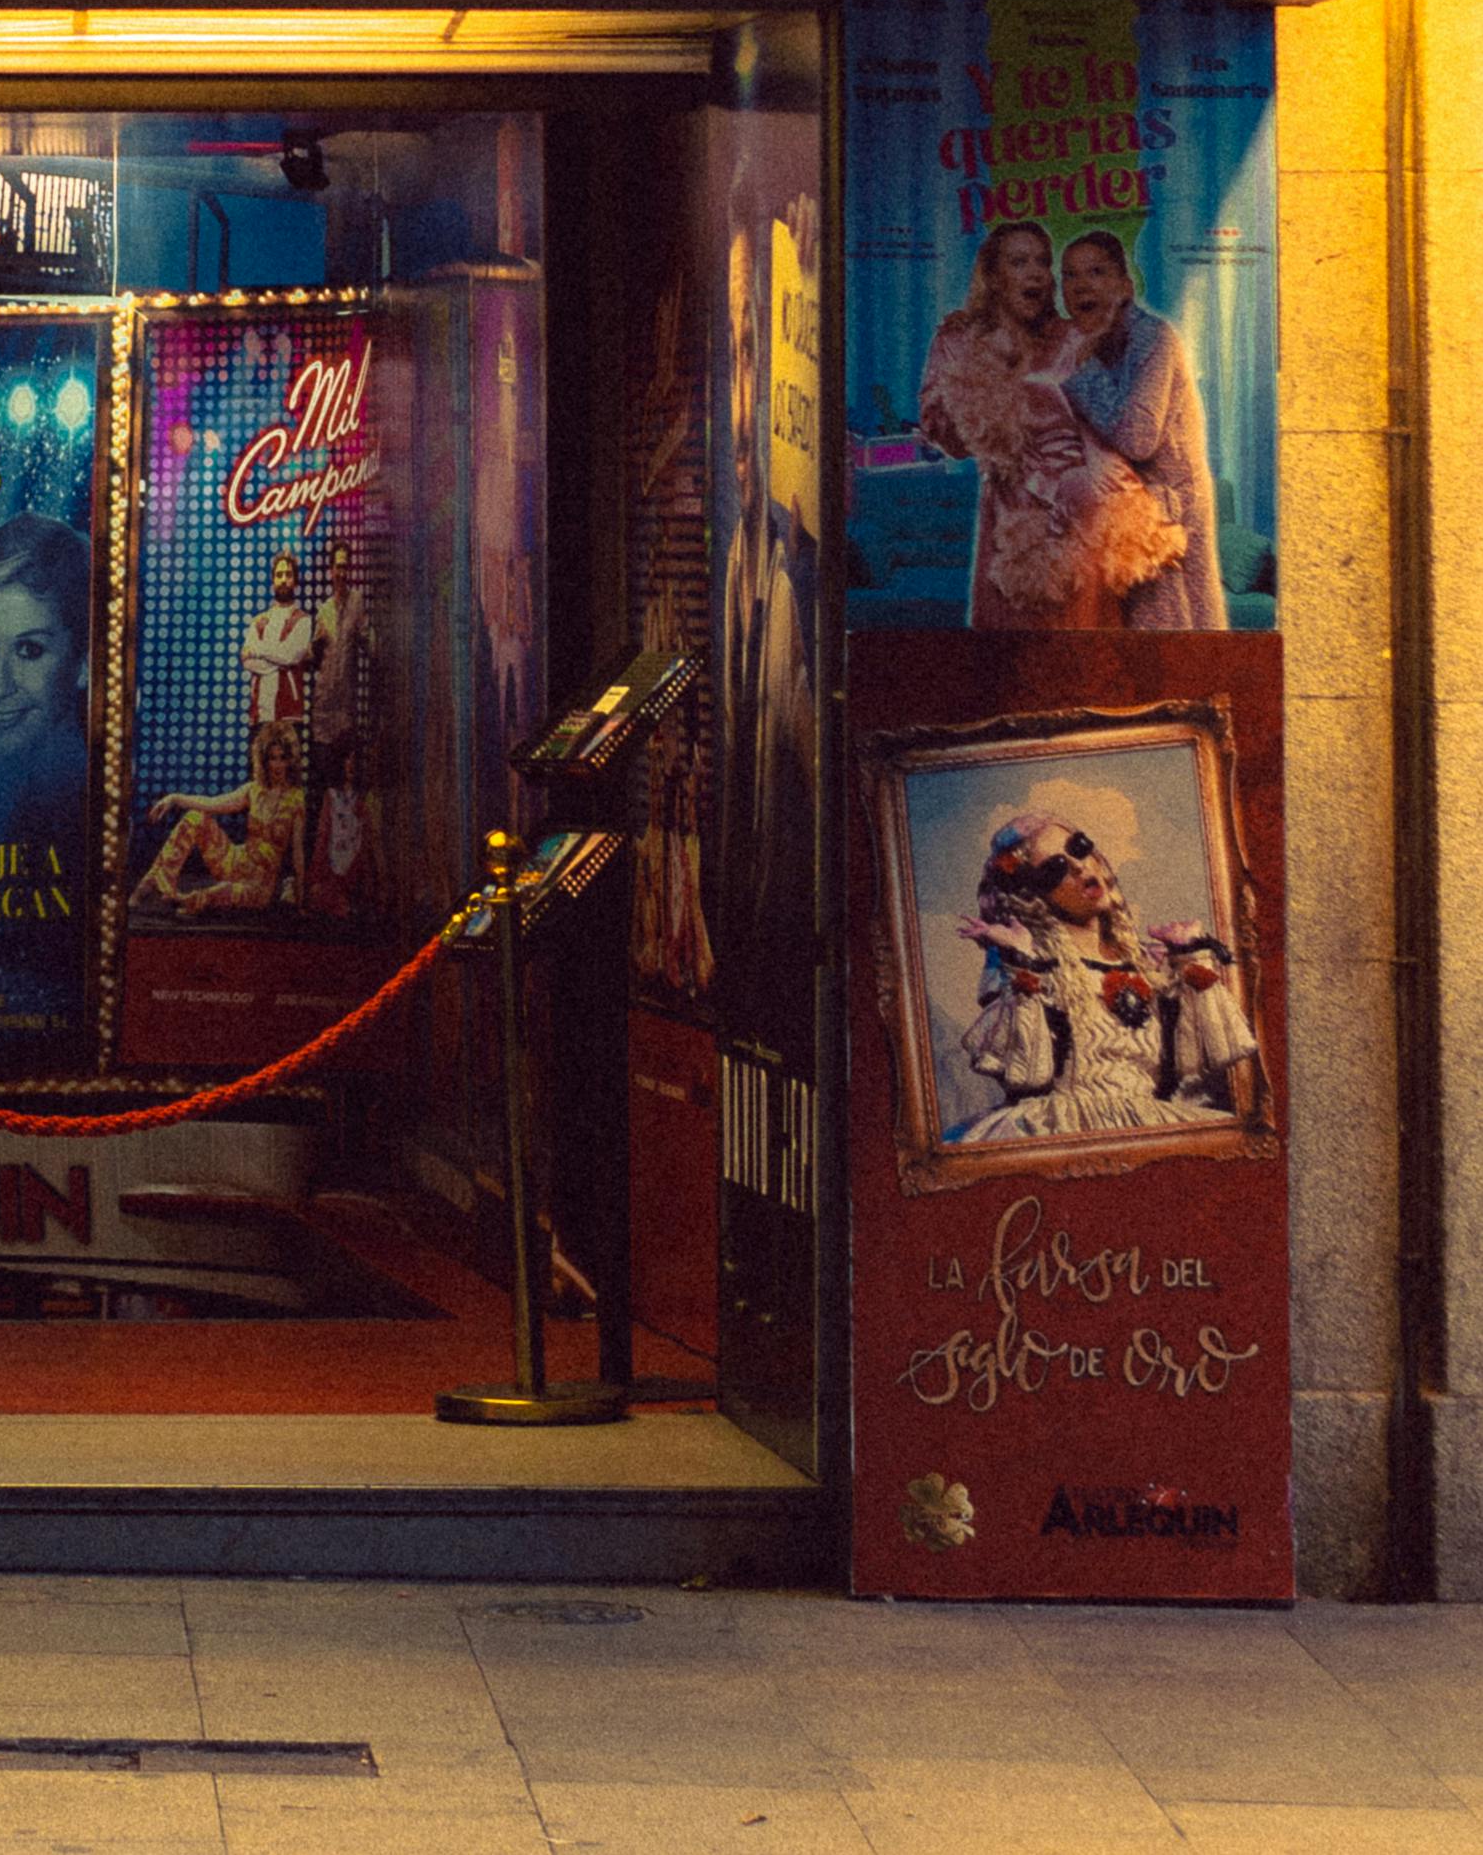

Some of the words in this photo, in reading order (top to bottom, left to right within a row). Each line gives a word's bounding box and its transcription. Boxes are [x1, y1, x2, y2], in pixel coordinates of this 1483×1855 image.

[1018, 63, 1071, 111] te
[1083, 53, 1139, 104] lo
[956, 161, 1167, 235] perder
[289, 339, 372, 453] Mil
[41, 843, 63, 876] A
[927, 1256, 965, 1290] LA
[977, 1194, 1151, 1312] farsa
[1161, 1257, 1214, 1289] DEL
[1069, 1347, 1106, 1378] DE
[1039, 1484, 1240, 1539] ARLEQUIN
